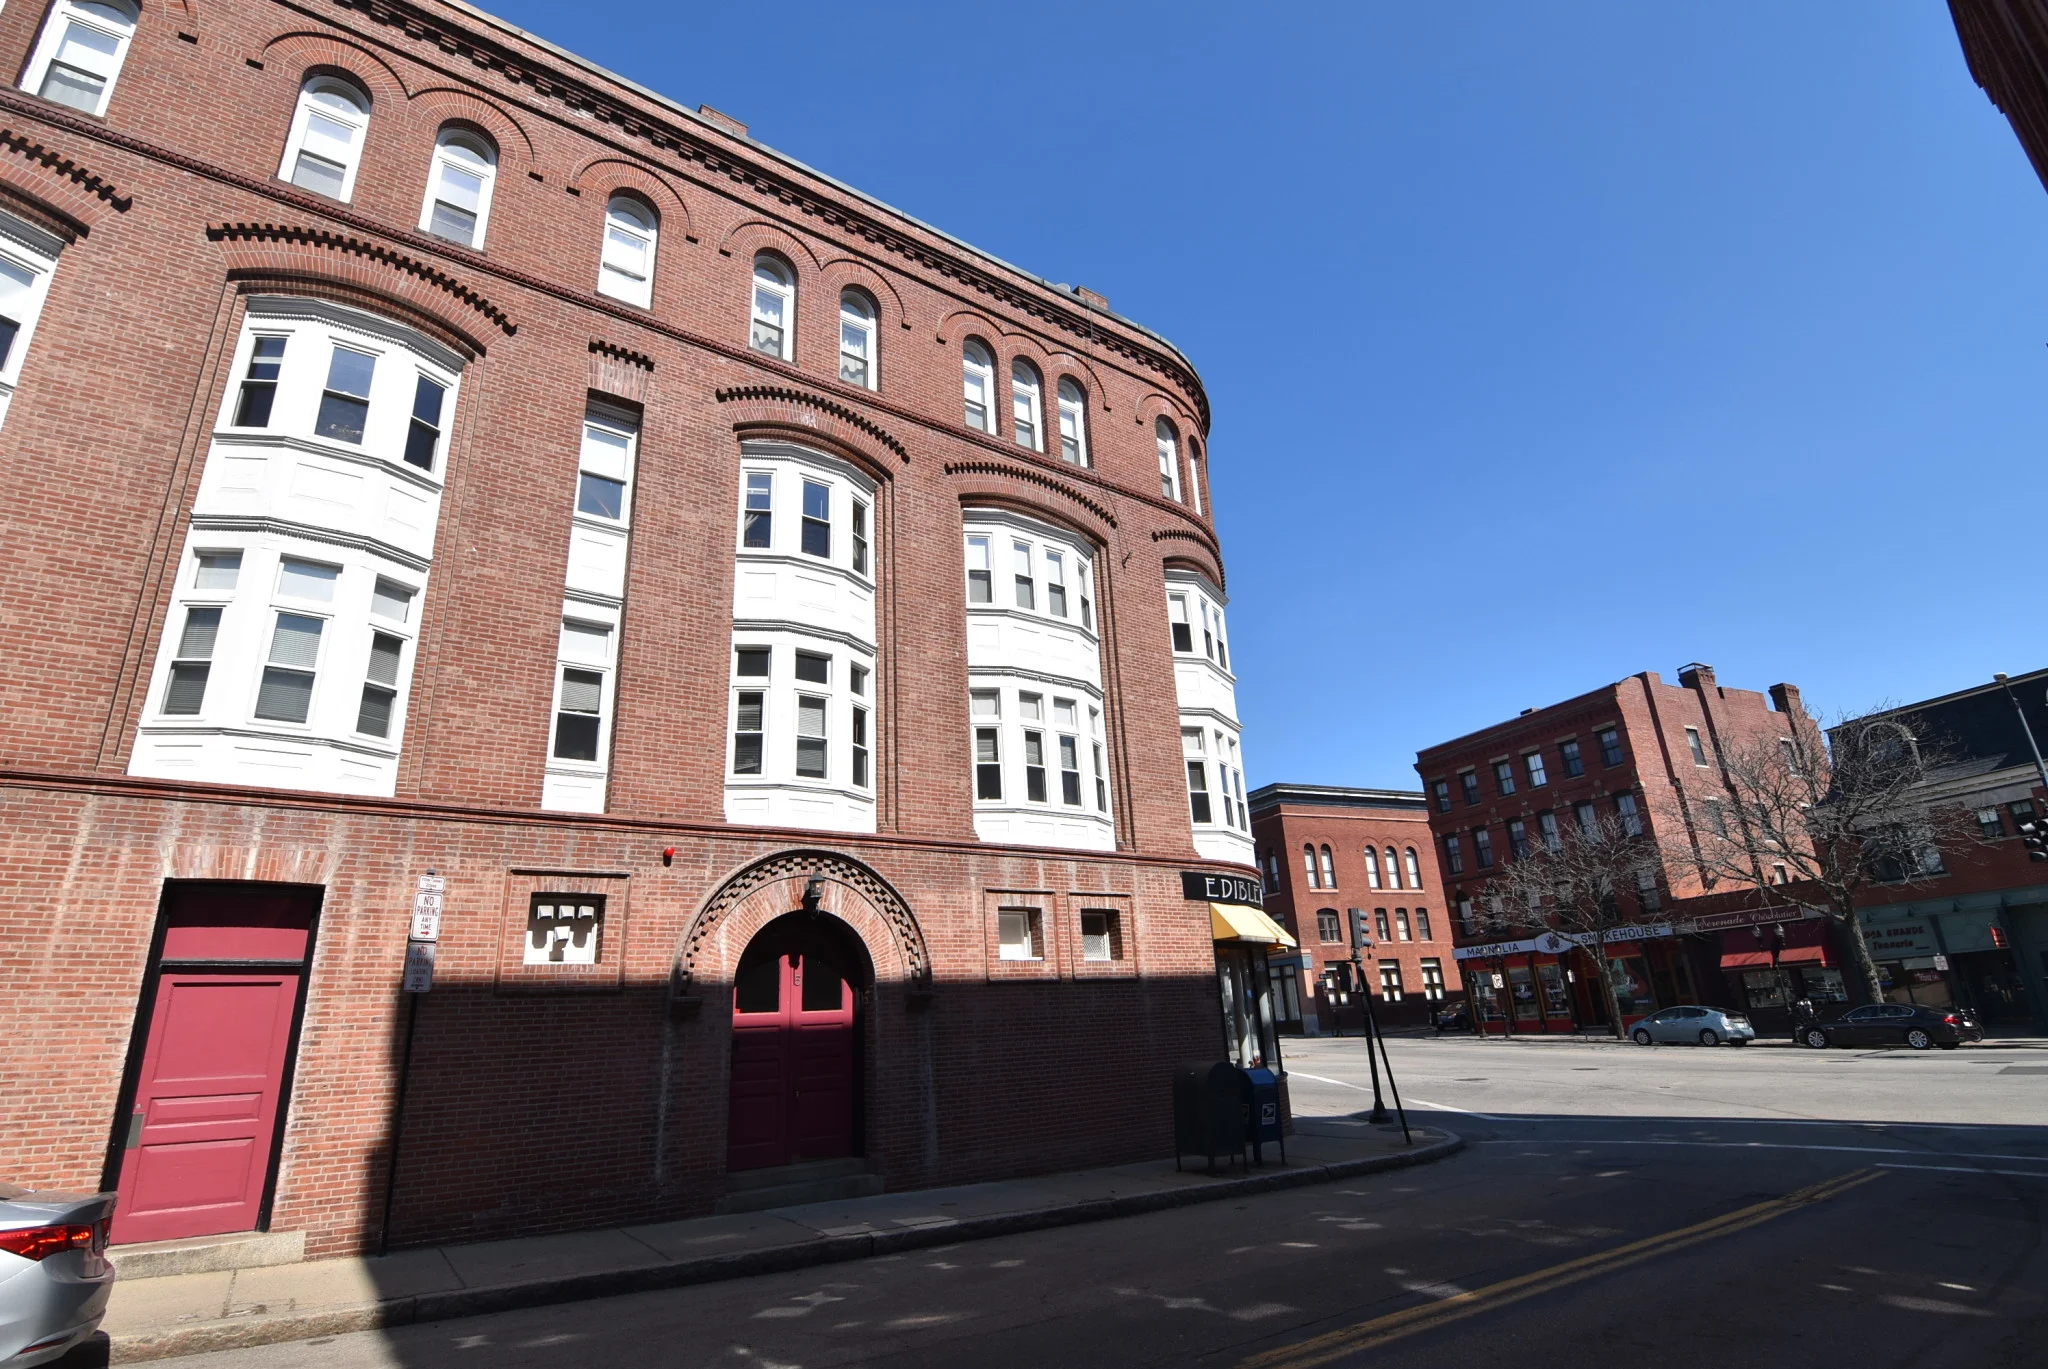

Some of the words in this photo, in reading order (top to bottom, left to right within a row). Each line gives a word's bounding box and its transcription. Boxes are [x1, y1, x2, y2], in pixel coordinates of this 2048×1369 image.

[423, 896, 435, 907] NO
[417, 905, 439, 917] PARKING
[420, 923, 432, 931] TIME
[1699, 914, 1746, 930] Serenade
[1581, 926, 1661, 944] SMKEHOUSE
[1886, 925, 1925, 937] GRANDE
[416, 946, 428, 956] NO
[408, 956, 433, 968] PARKING
